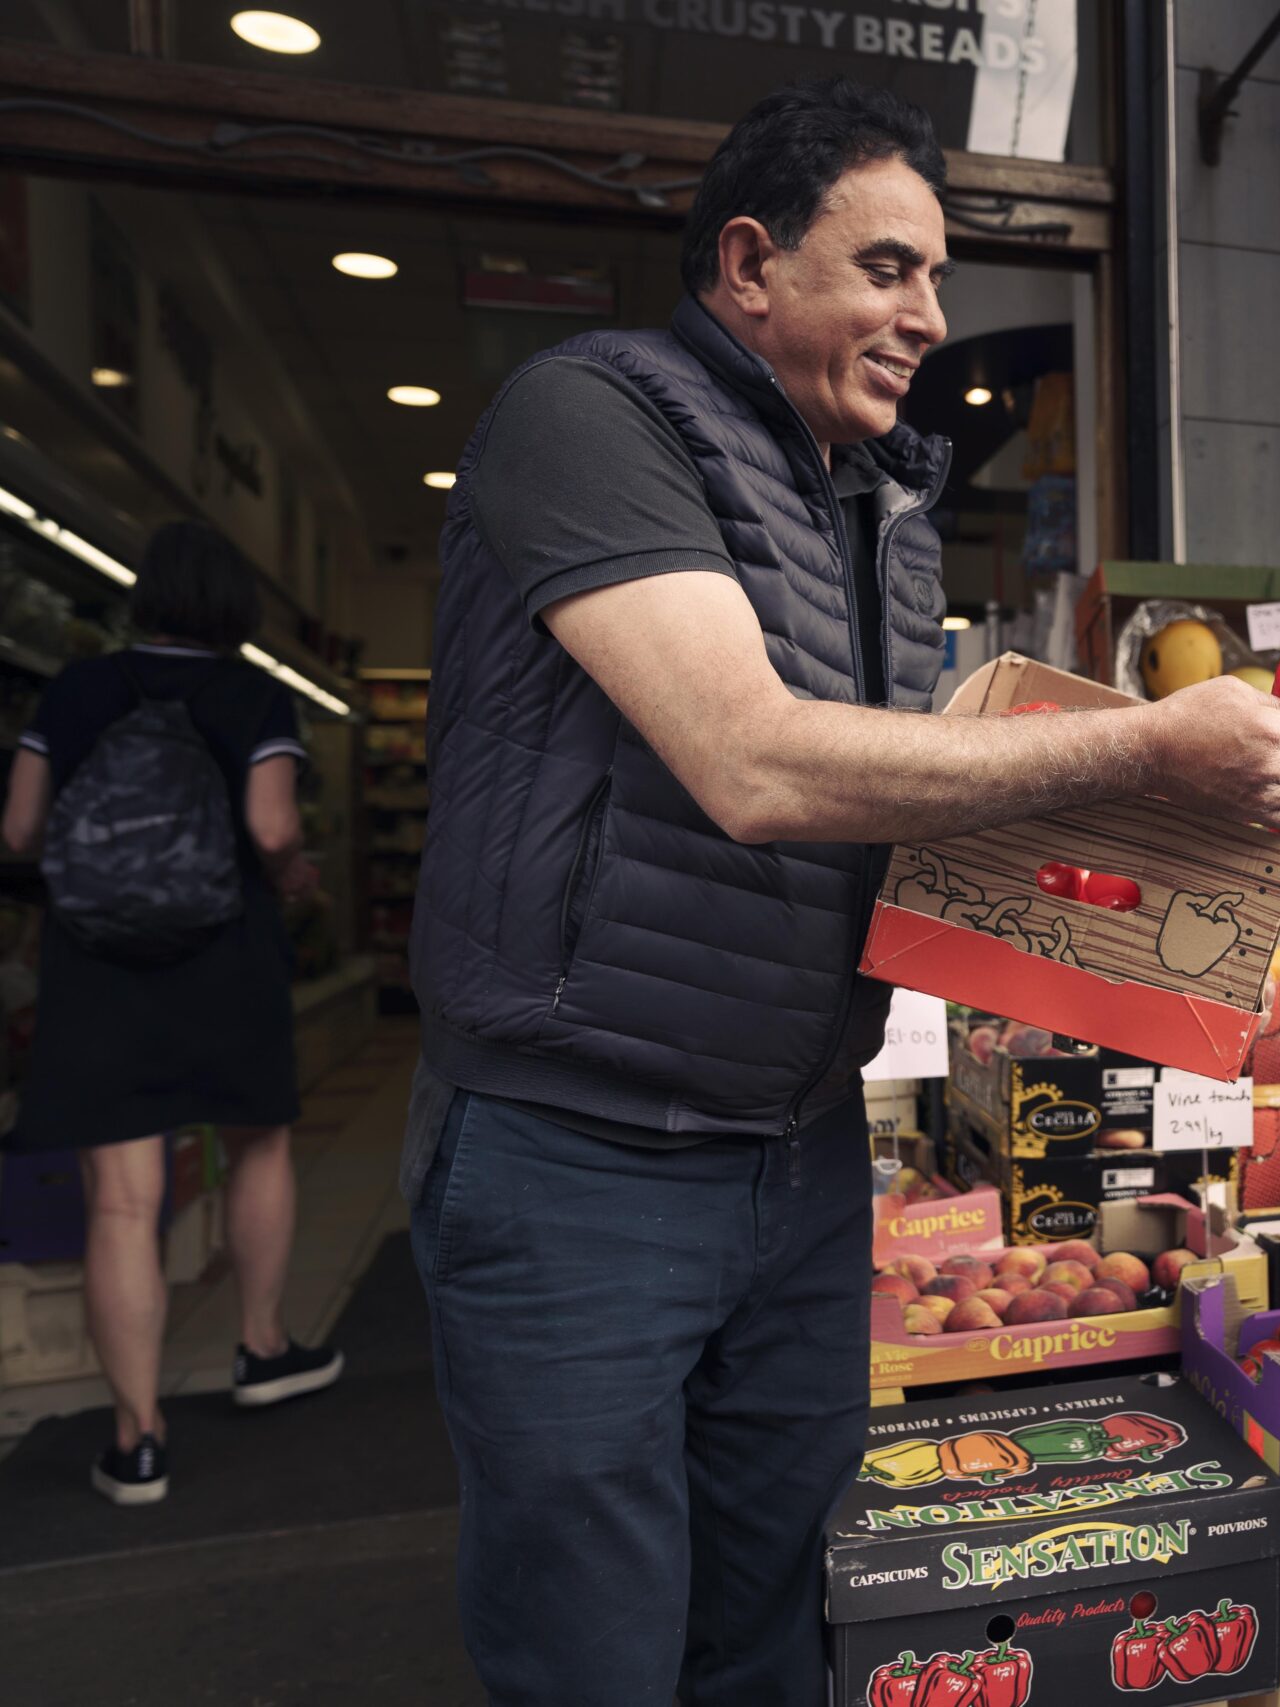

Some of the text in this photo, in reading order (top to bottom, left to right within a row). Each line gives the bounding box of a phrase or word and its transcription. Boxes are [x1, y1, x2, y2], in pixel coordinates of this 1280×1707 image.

[854, 15, 1046, 74] BREADS
[1168, 1092, 1201, 1107] Vine
[889, 1206, 986, 1240] Caprice
[989, 1324, 1117, 1363] Caprice
[867, 1394, 1126, 1436] PAPRIKA'S CAPSICUMS POIVRONS
[942, 1468, 1133, 1502] Quality Products
[1206, 1517, 1268, 1537] POIVRONS
[849, 1566, 929, 1588] CAPSICUMS
[1016, 1597, 1126, 1629] Quality Products
